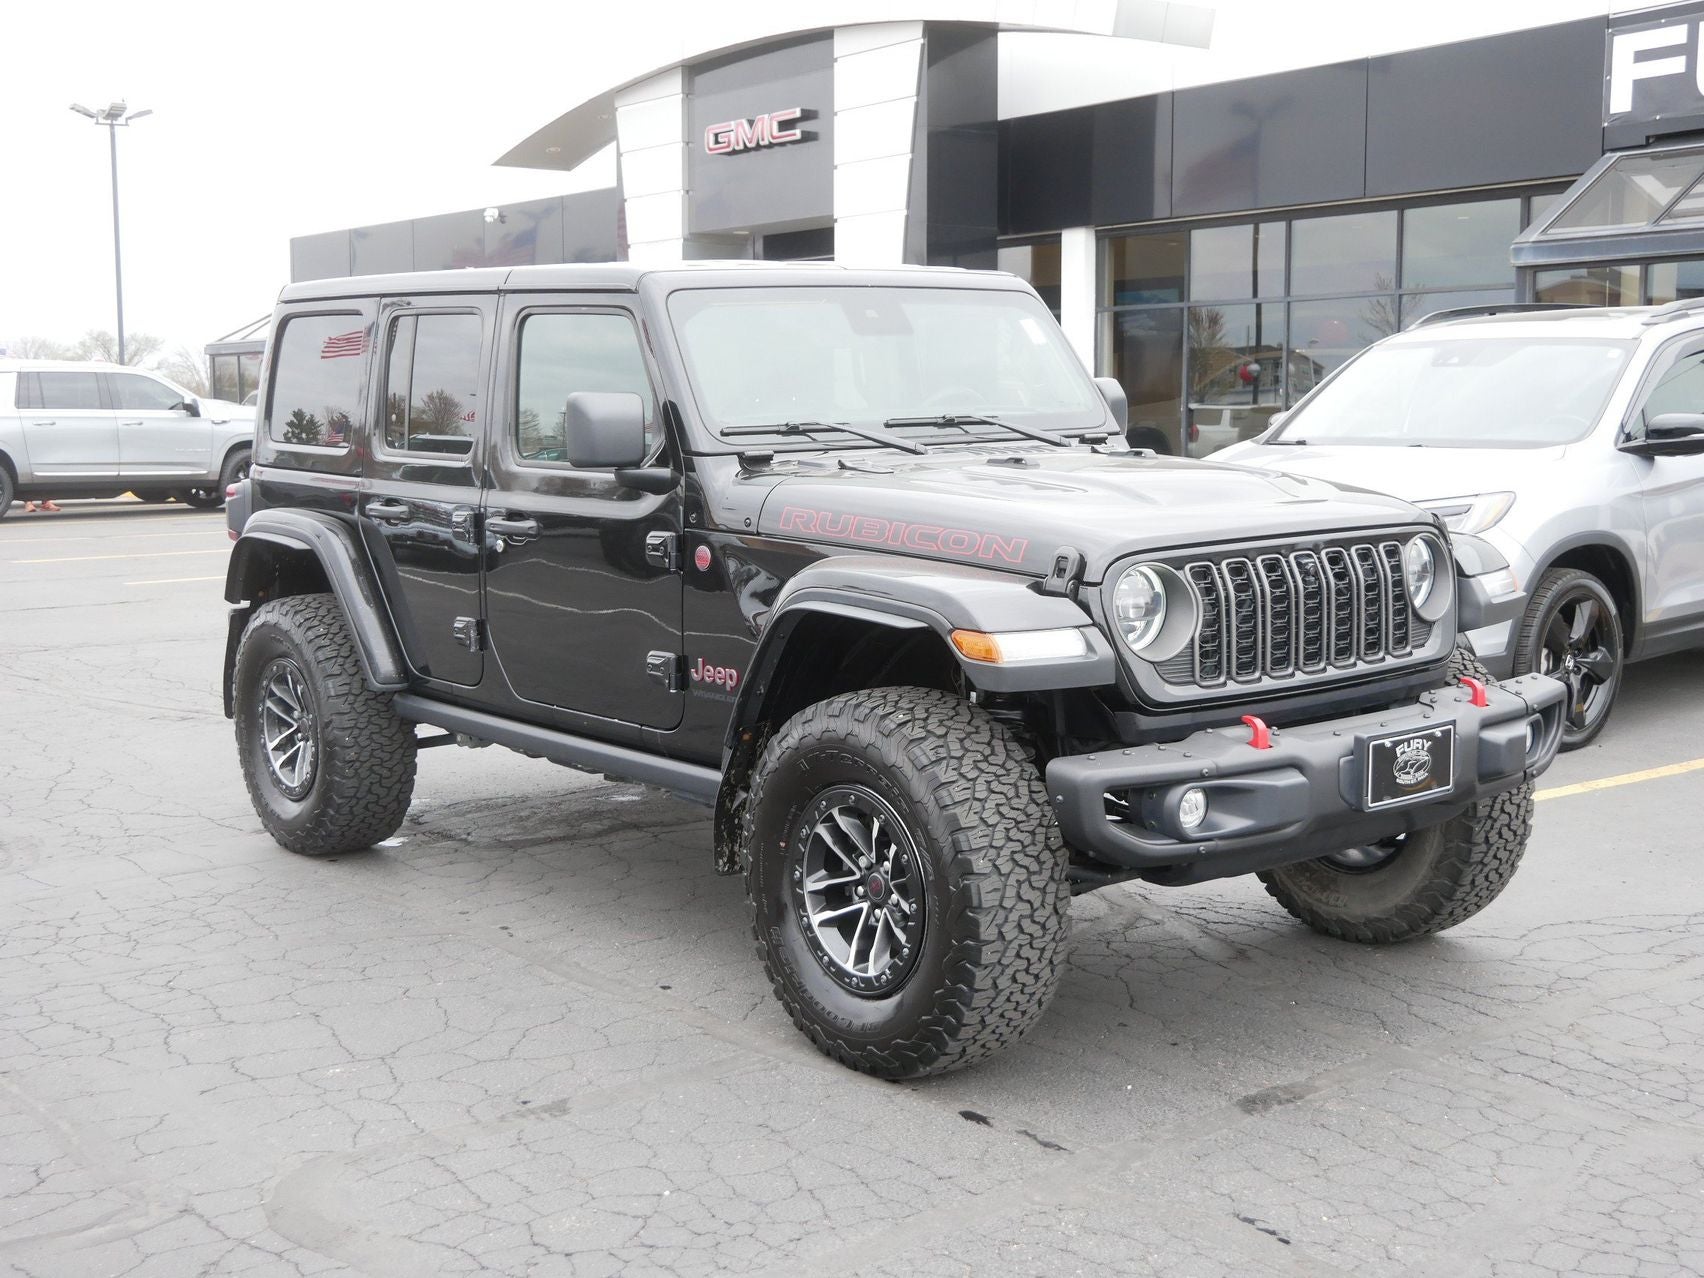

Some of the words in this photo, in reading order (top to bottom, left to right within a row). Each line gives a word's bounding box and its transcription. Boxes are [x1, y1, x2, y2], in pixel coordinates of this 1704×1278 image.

[1609, 20, 1704, 114] F
[704, 106, 802, 155] GMC
[779, 505, 1030, 564] RUBICON
[690, 657, 739, 692] Jeep
[1396, 738, 1432, 757] FURY
